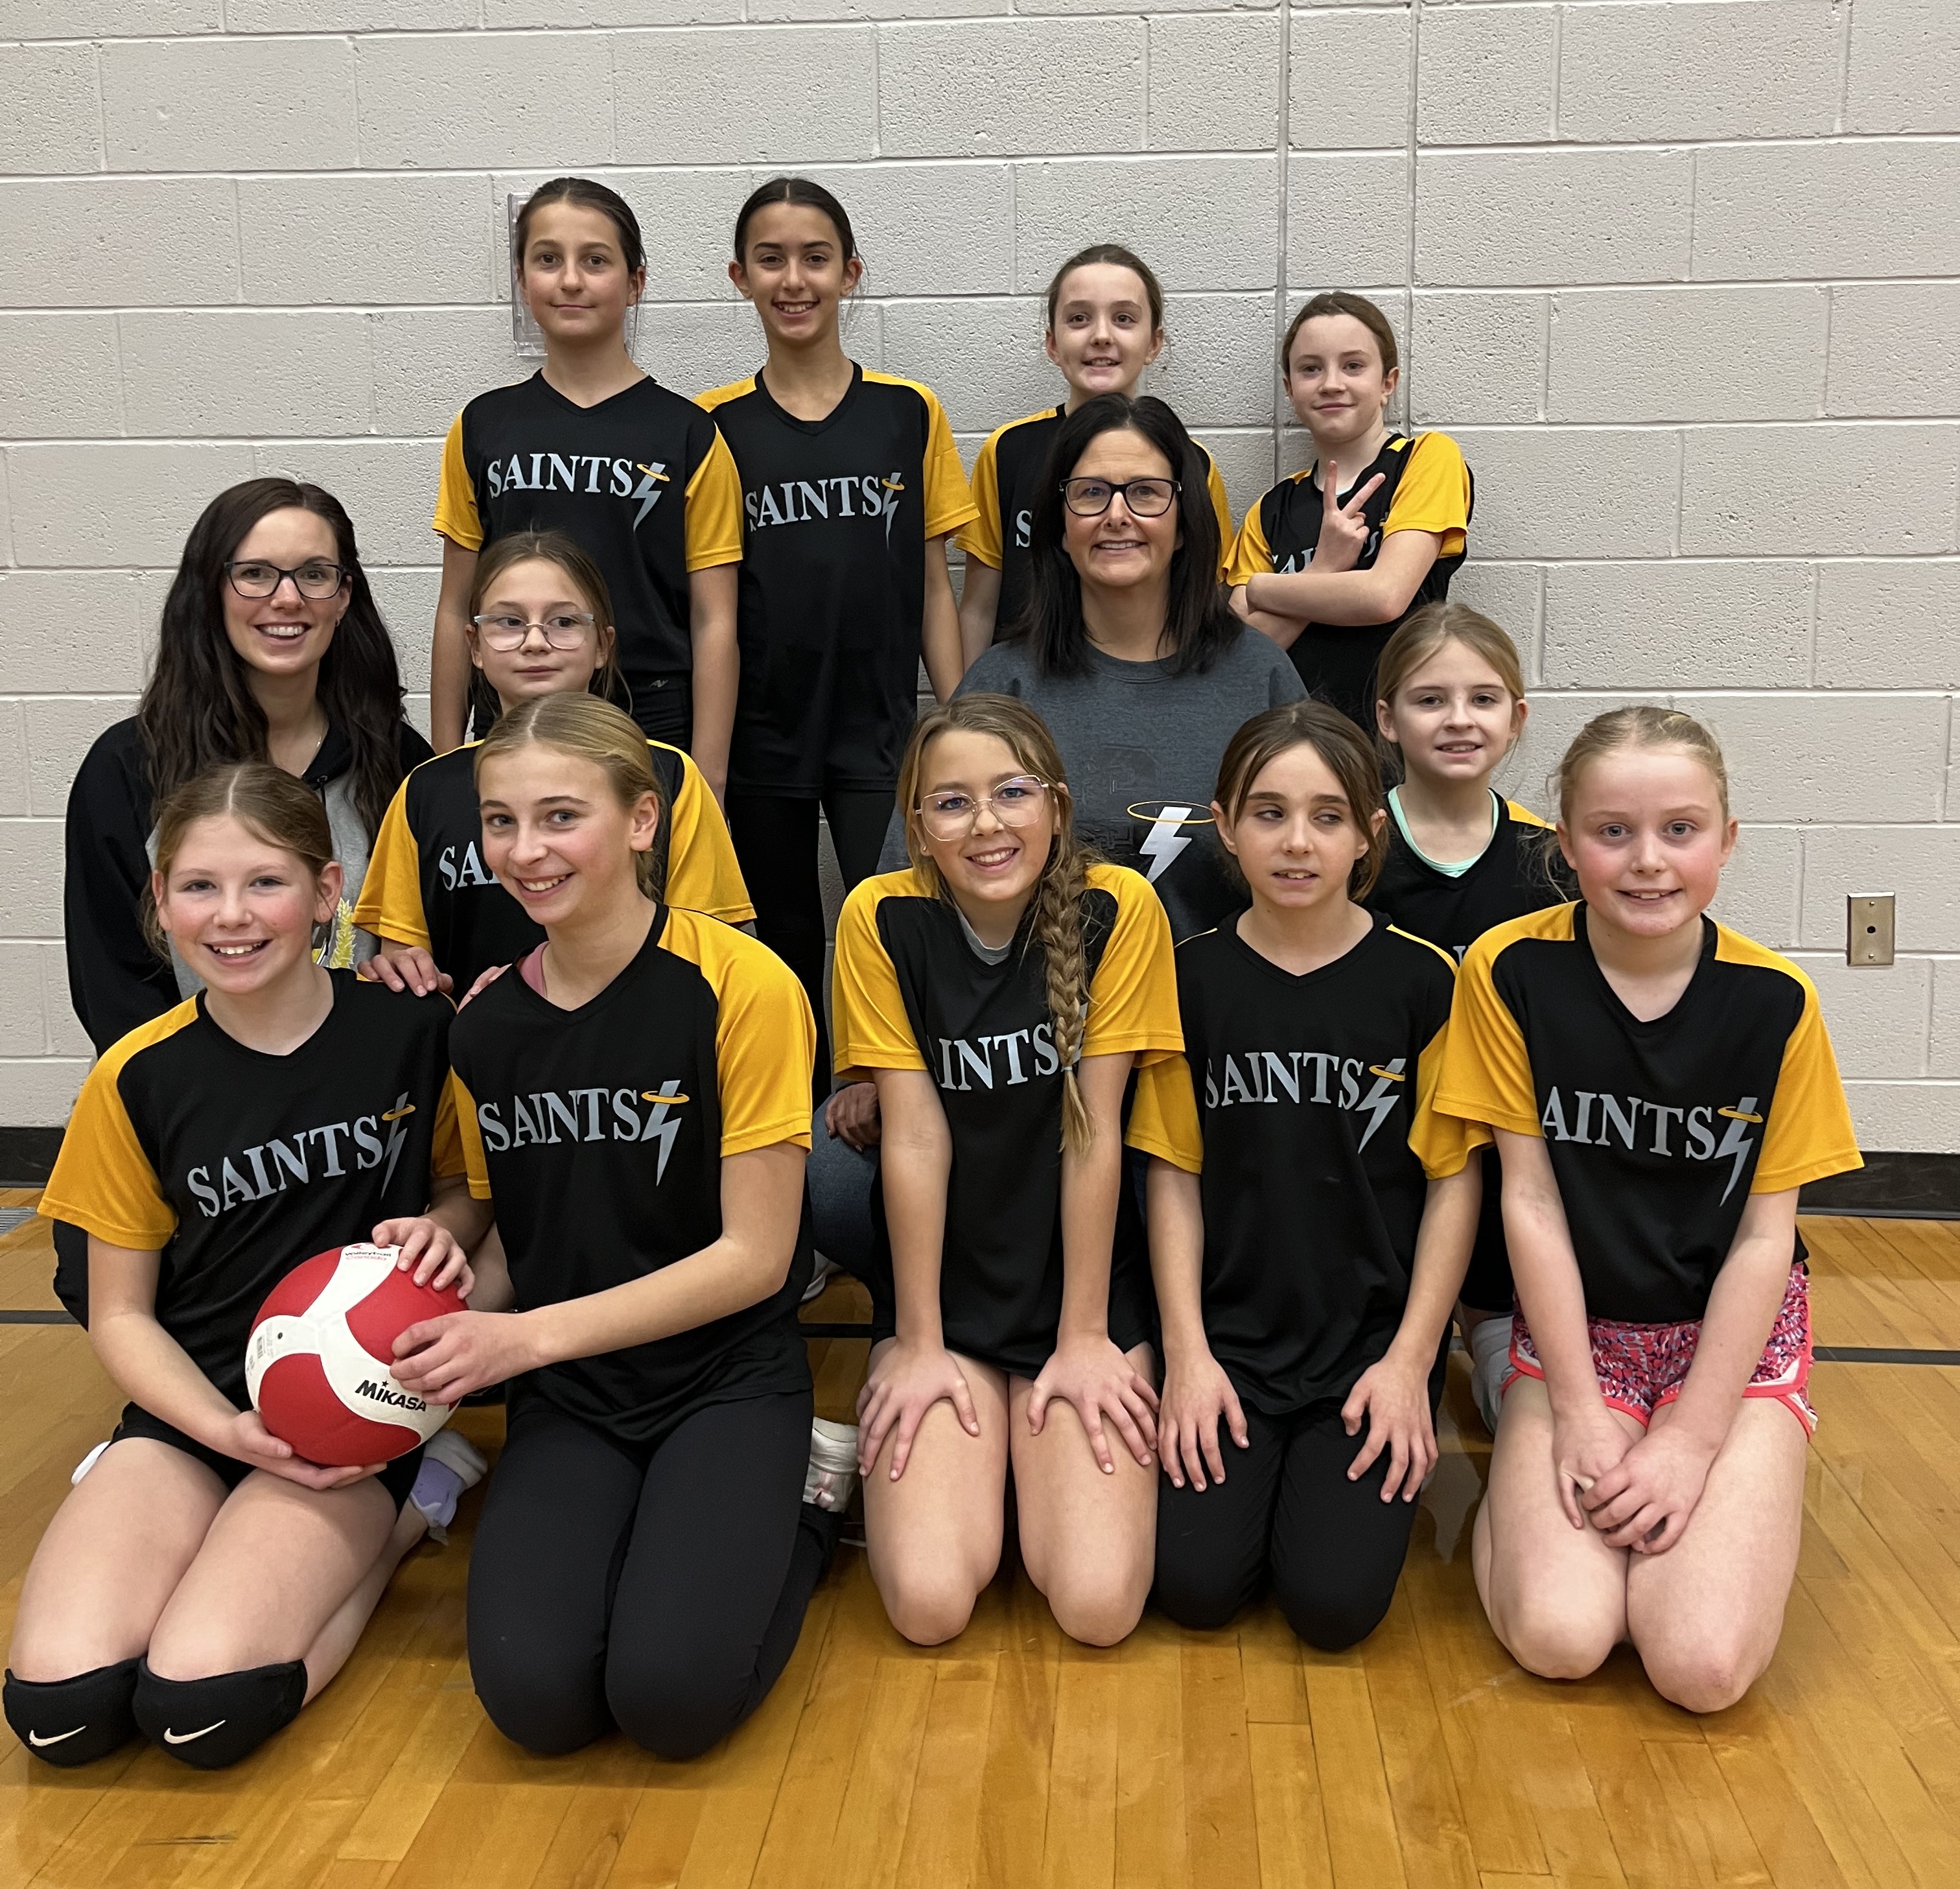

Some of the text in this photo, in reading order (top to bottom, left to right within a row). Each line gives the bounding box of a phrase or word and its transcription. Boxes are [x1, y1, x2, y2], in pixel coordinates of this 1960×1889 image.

[487, 452, 633, 499] SAINTS
[745, 475, 882, 532] SAINTS
[937, 1022, 1059, 1090] INTS
[1205, 1051, 1364, 1110] SAINTS
[478, 1088, 640, 1151] SAINTS
[1541, 1086, 1716, 1160] AINTS
[187, 1114, 383, 1217] SAINTS
